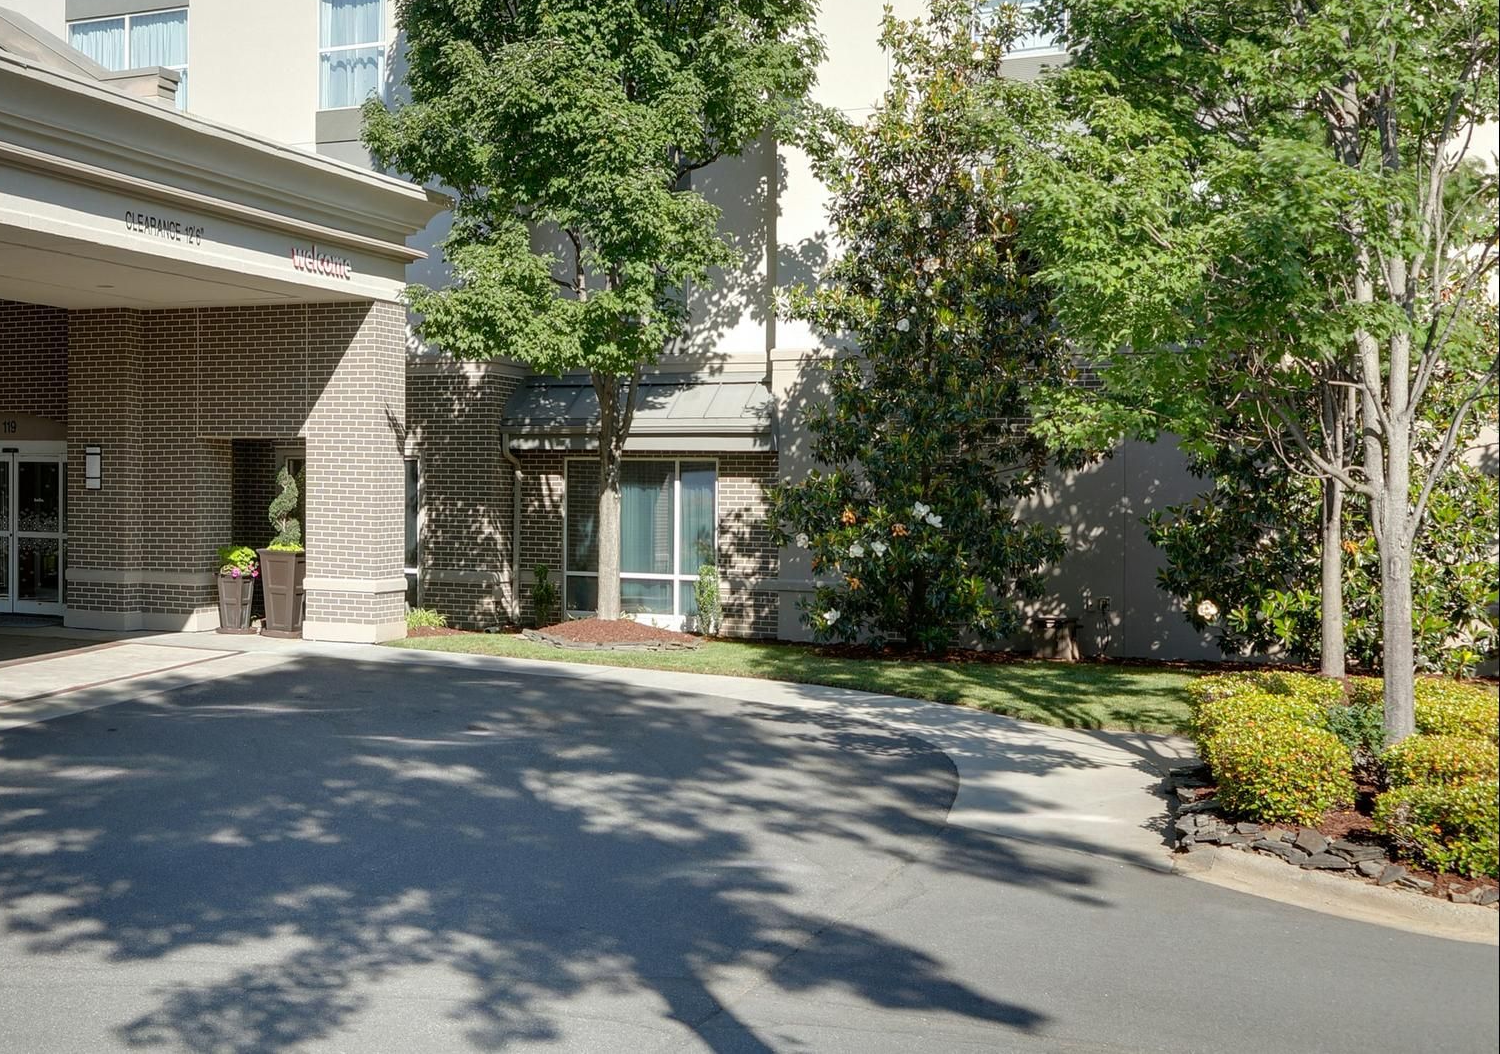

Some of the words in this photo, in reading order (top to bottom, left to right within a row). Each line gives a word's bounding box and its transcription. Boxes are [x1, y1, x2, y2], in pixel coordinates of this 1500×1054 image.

[125, 210, 181, 242] CLEARANCE
[291, 245, 352, 279] welcome
[2, 419, 17, 434] 119
